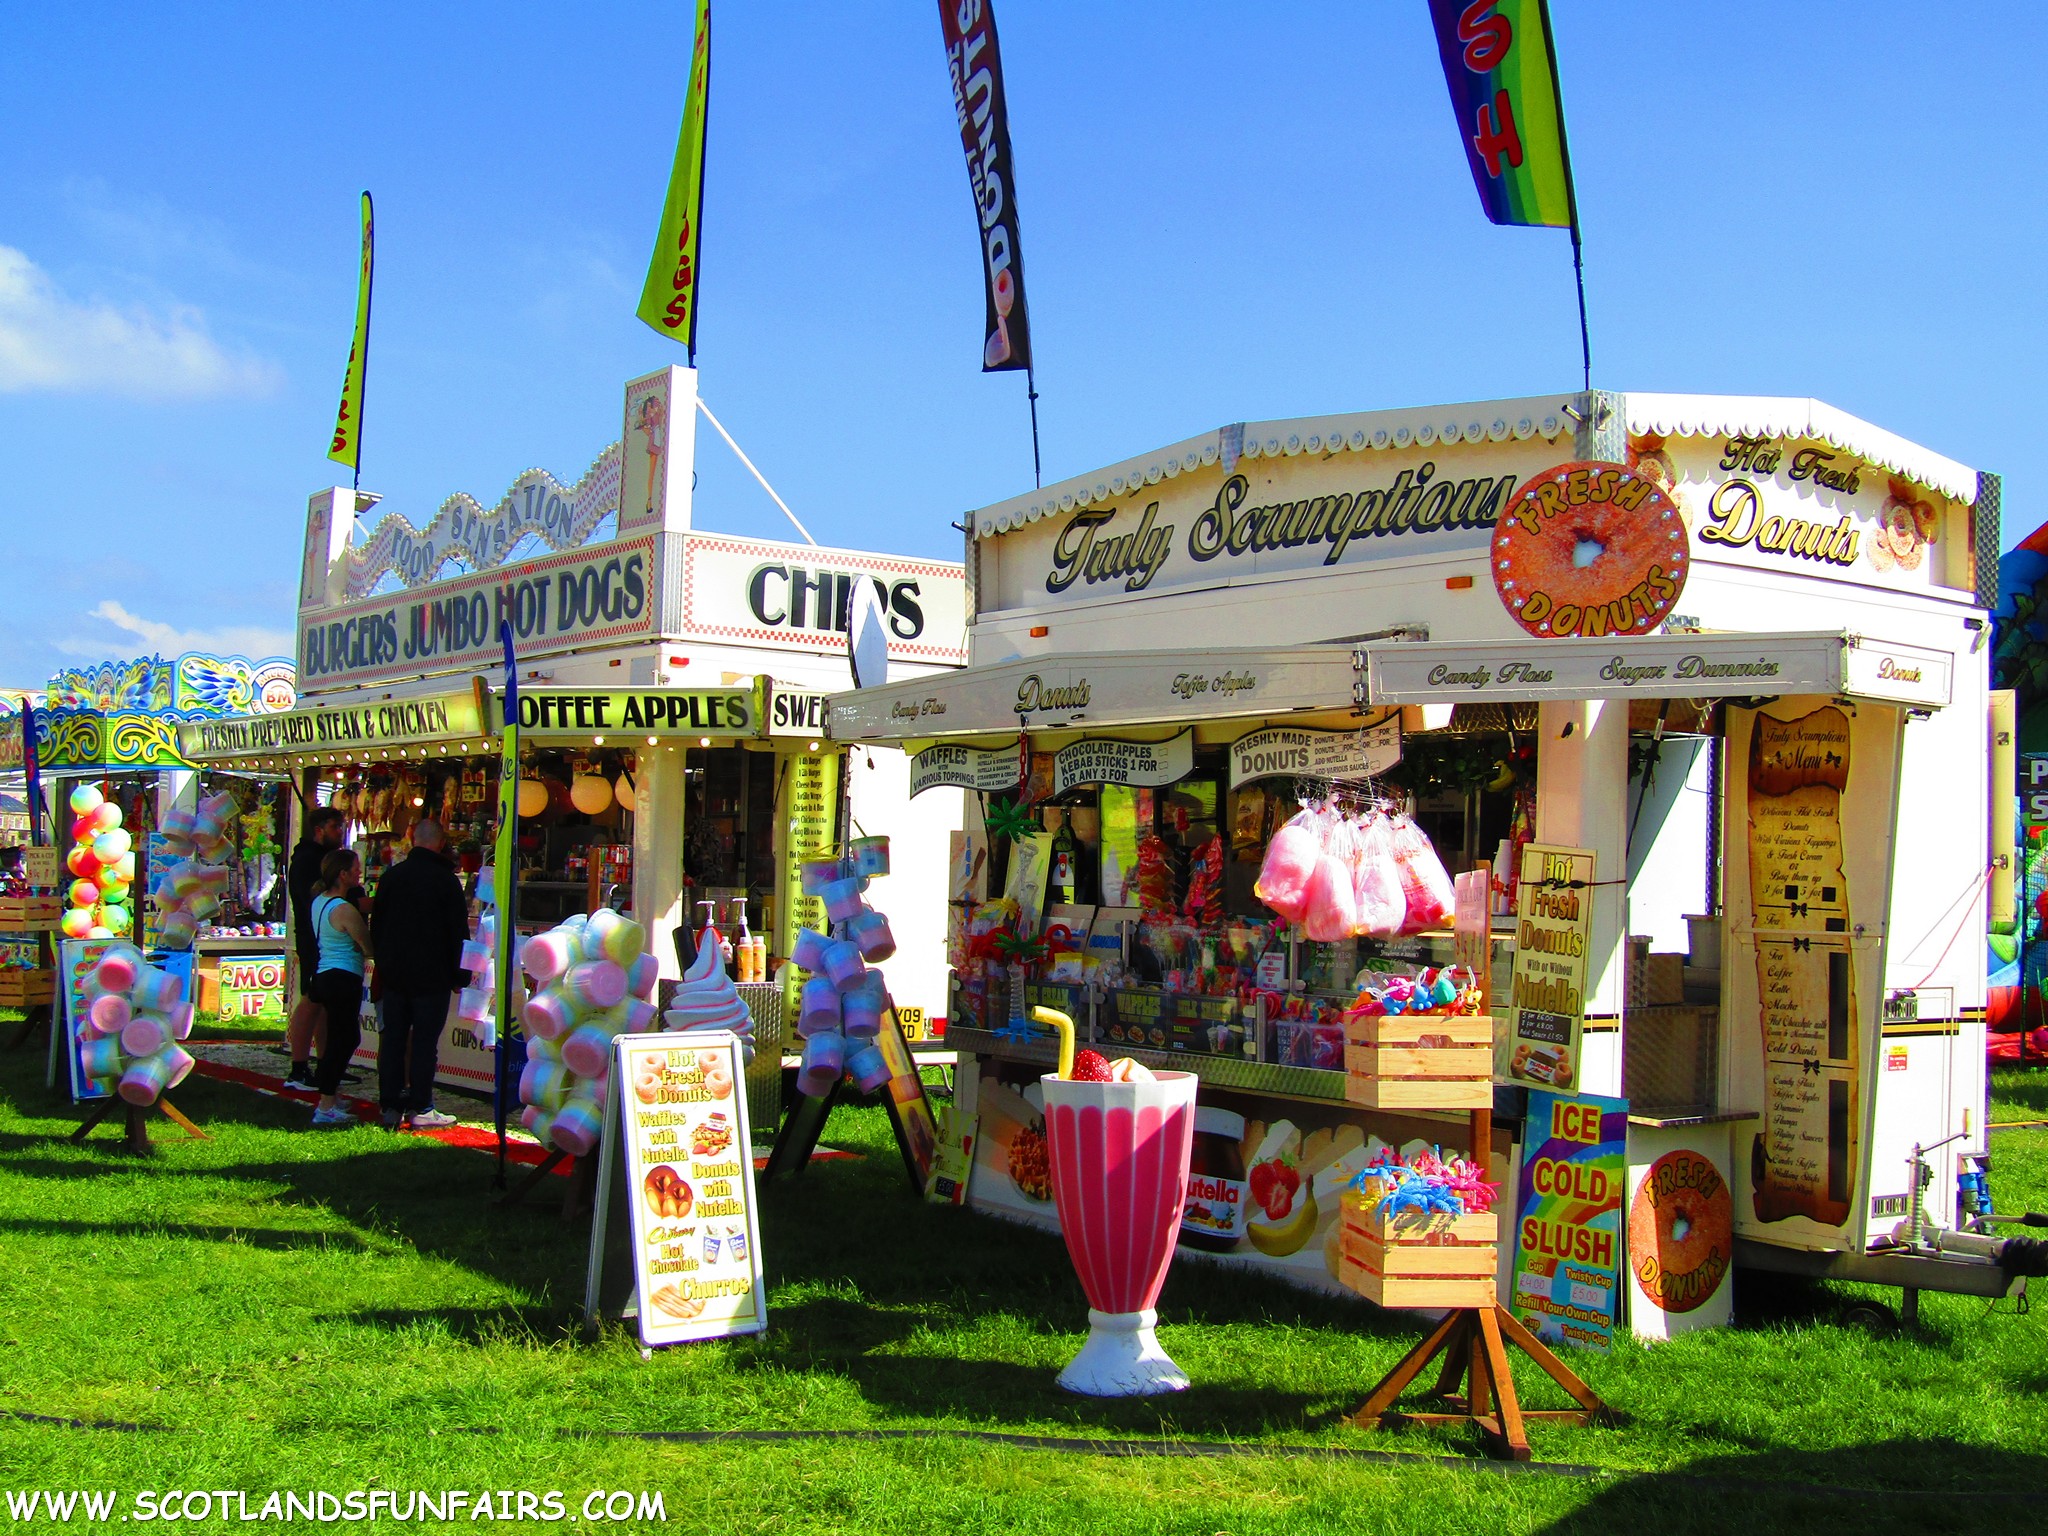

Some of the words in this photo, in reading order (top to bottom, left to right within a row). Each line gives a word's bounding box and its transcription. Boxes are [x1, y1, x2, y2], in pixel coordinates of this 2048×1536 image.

[1720, 435, 1783, 476] Hot
[1788, 446, 1861, 497] Fresh
[1512, 469, 1653, 536] FRESH
[391, 527, 434, 578] FOOD
[451, 484, 575, 551] SENSATION
[1046, 500, 1175, 594] Truly
[1189, 461, 1518, 565] Scrumptious
[1700, 478, 1861, 567] Donuts
[1519, 565, 1677, 639] DONUTS
[305, 609, 397, 677] BURGERS
[404, 590, 488, 659] JUMBO
[494, 577, 551, 643] HOT
[557, 553, 645, 631] DOGS
[1428, 663, 1491, 689] Candy
[1495, 662, 1552, 684] Floss
[1599, 656, 1666, 684] Sugar
[1673, 655, 1779, 680] Dummies
[1876, 657, 1922, 683] Donuts
[1013, 672, 1092, 714] Donuts
[1171, 672, 1208, 699] Toffee
[1210, 669, 1256, 693] Apples
[624, 693, 750, 730] APPLES
[201, 720, 248, 755] FRESHLY
[252, 715, 313, 749] PREPARED
[317, 710, 362, 744] STEAK
[365, 713, 375, 734] &
[379, 699, 447, 735] CHICKEN
[1764, 727, 1791, 746] Truly
[1793, 725, 1847, 746] Scrumptious
[1233, 732, 1280, 758] FRESHLY
[1281, 733, 1312, 747] MADE
[1314, 735, 1335, 745] DONUTS
[1343, 732, 1354, 741] FOR
[1314, 745, 1335, 755] DONUTS
[1343, 743, 1354, 751] FOR
[1379, 739, 1390, 747] FOR
[919, 748, 968, 770] WAFFLES
[1059, 743, 1114, 764] CHOCOLATE
[1116, 746, 1152, 759] APPLES
[1241, 748, 1310, 774] DONUTS
[1782, 744, 1822, 770] Menu
[1061, 757, 1093, 776] KEBAB
[1095, 755, 1129, 769] STICKS
[1130, 759, 1136, 770] 1
[1138, 760, 1158, 771] FOR
[913, 773, 942, 792] VARIOUS
[942, 771, 975, 785] TOPPINGS
[1062, 773, 1077, 788] OR
[1079, 770, 1099, 782] ANY
[1100, 769, 1107, 780] 3
[1109, 771, 1128, 783] FOR
[1543, 851, 1573, 885] Hot
[1529, 885, 1580, 922] Fresh
[1520, 919, 1584, 958] Donuts
[1767, 948, 1784, 961] Tea
[1527, 958, 1541, 971] With
[1541, 962, 1549, 973] or
[1549, 963, 1573, 977] Without
[1767, 965, 1793, 980] Coffee
[241, 993, 267, 1017] IF
[1514, 972, 1579, 1017] Nutella
[1767, 999, 1799, 1011] Mocha
[451, 1027, 478, 1049] CHIPS
[1767, 1040, 1788, 1053] Cold
[667, 1050, 695, 1068] Hot
[661, 1067, 705, 1086] Fresh
[656, 1085, 712, 1105] Donuts
[637, 1110, 686, 1128] Waffles
[1552, 1101, 1601, 1143] ICE
[649, 1128, 677, 1145] with
[641, 1145, 689, 1165] Nutella
[691, 1160, 741, 1181] Donuts
[1534, 1158, 1609, 1204] COLD
[702, 1179, 732, 1198] with
[1187, 1178, 1239, 1203] utella
[1644, 1157, 1722, 1209] FRESH
[695, 1198, 743, 1219] Nutella
[647, 1225, 696, 1245] Cadbury
[1521, 1216, 1614, 1270] SLUSH
[660, 1242, 685, 1260] Hot
[649, 1256, 699, 1275] Chocolate
[1527, 1258, 1545, 1273] Cup
[1639, 1246, 1724, 1302] DONUTS
[679, 1275, 750, 1301] Churros
[1565, 1267, 1594, 1288] Twisty
[1594, 1274, 1613, 1289] Cup
[1515, 1294, 1540, 1309] Refill
[1542, 1299, 1566, 1314] Your
[1566, 1306, 1589, 1320] Own
[1590, 1310, 1610, 1327] Cup
[1522, 1315, 1540, 1331] Cup
[1561, 1324, 1590, 1344] Twisty
[1590, 1332, 1608, 1346] Cup
